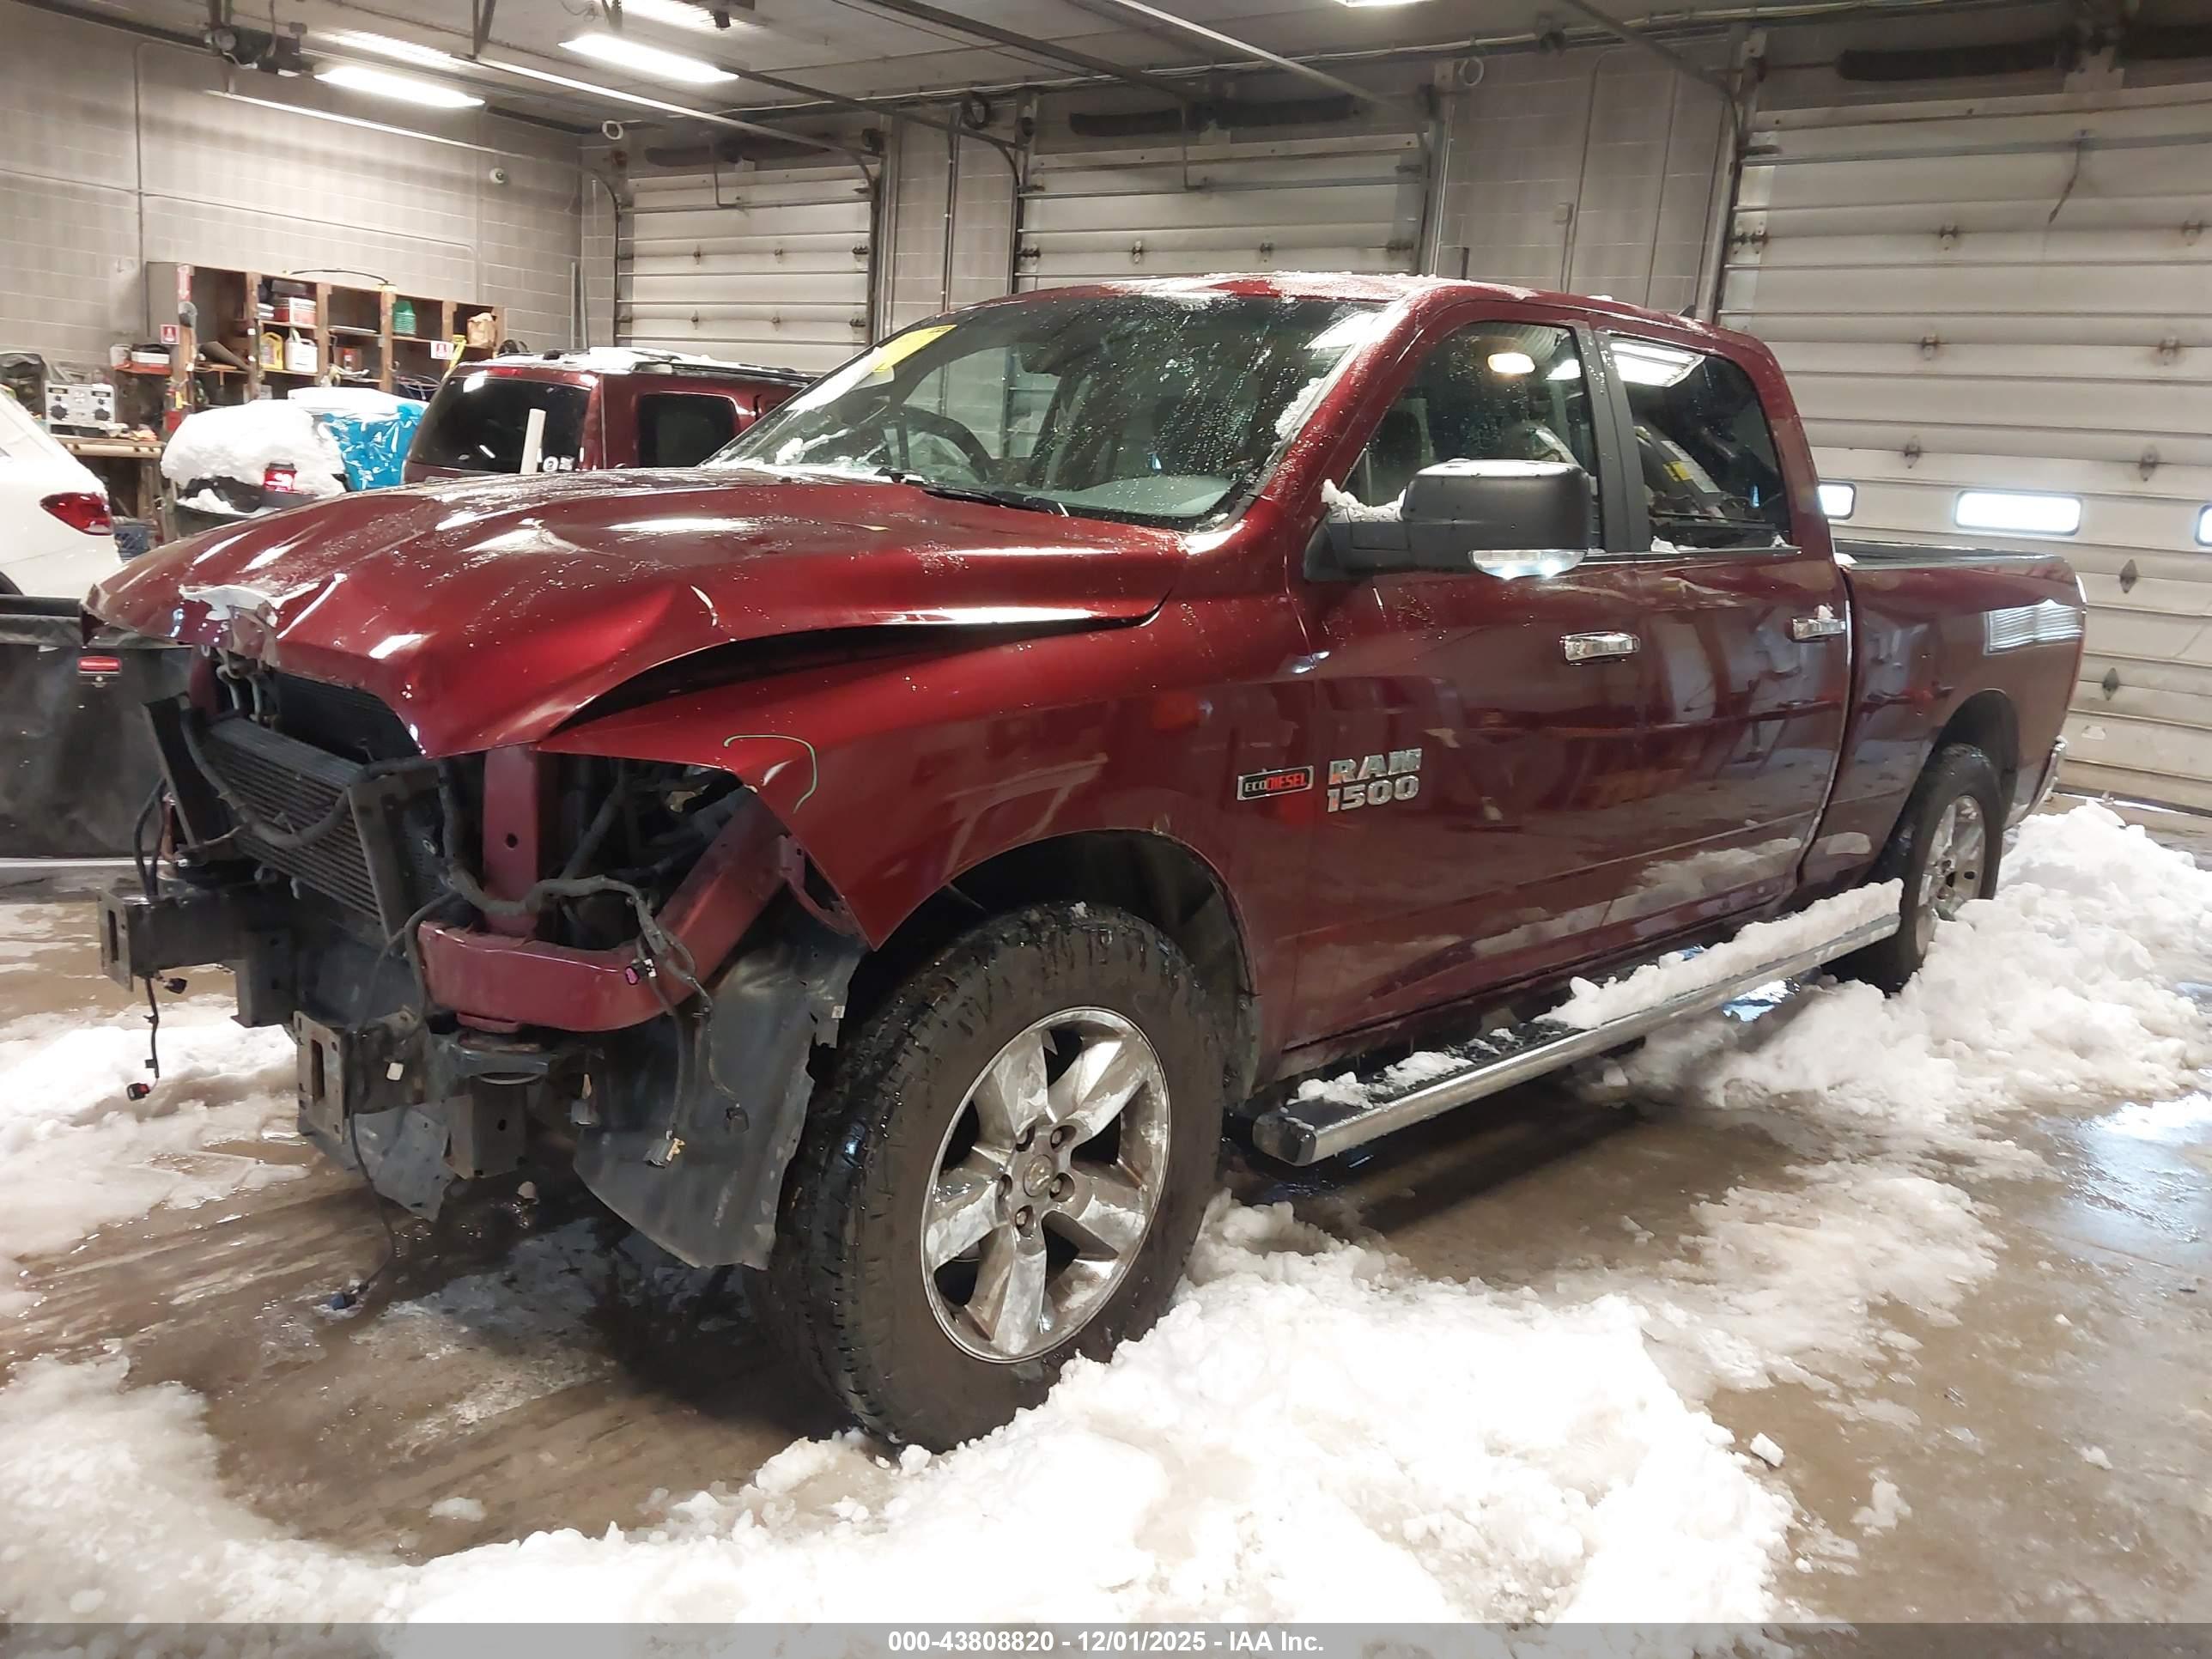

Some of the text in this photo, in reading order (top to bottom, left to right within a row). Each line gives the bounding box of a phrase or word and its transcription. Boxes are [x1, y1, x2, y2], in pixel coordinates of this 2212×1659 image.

[1244, 772, 1307, 793] ECODIESEL
[1328, 748, 1422, 785] RAM
[1327, 775, 1419, 812] 1500
